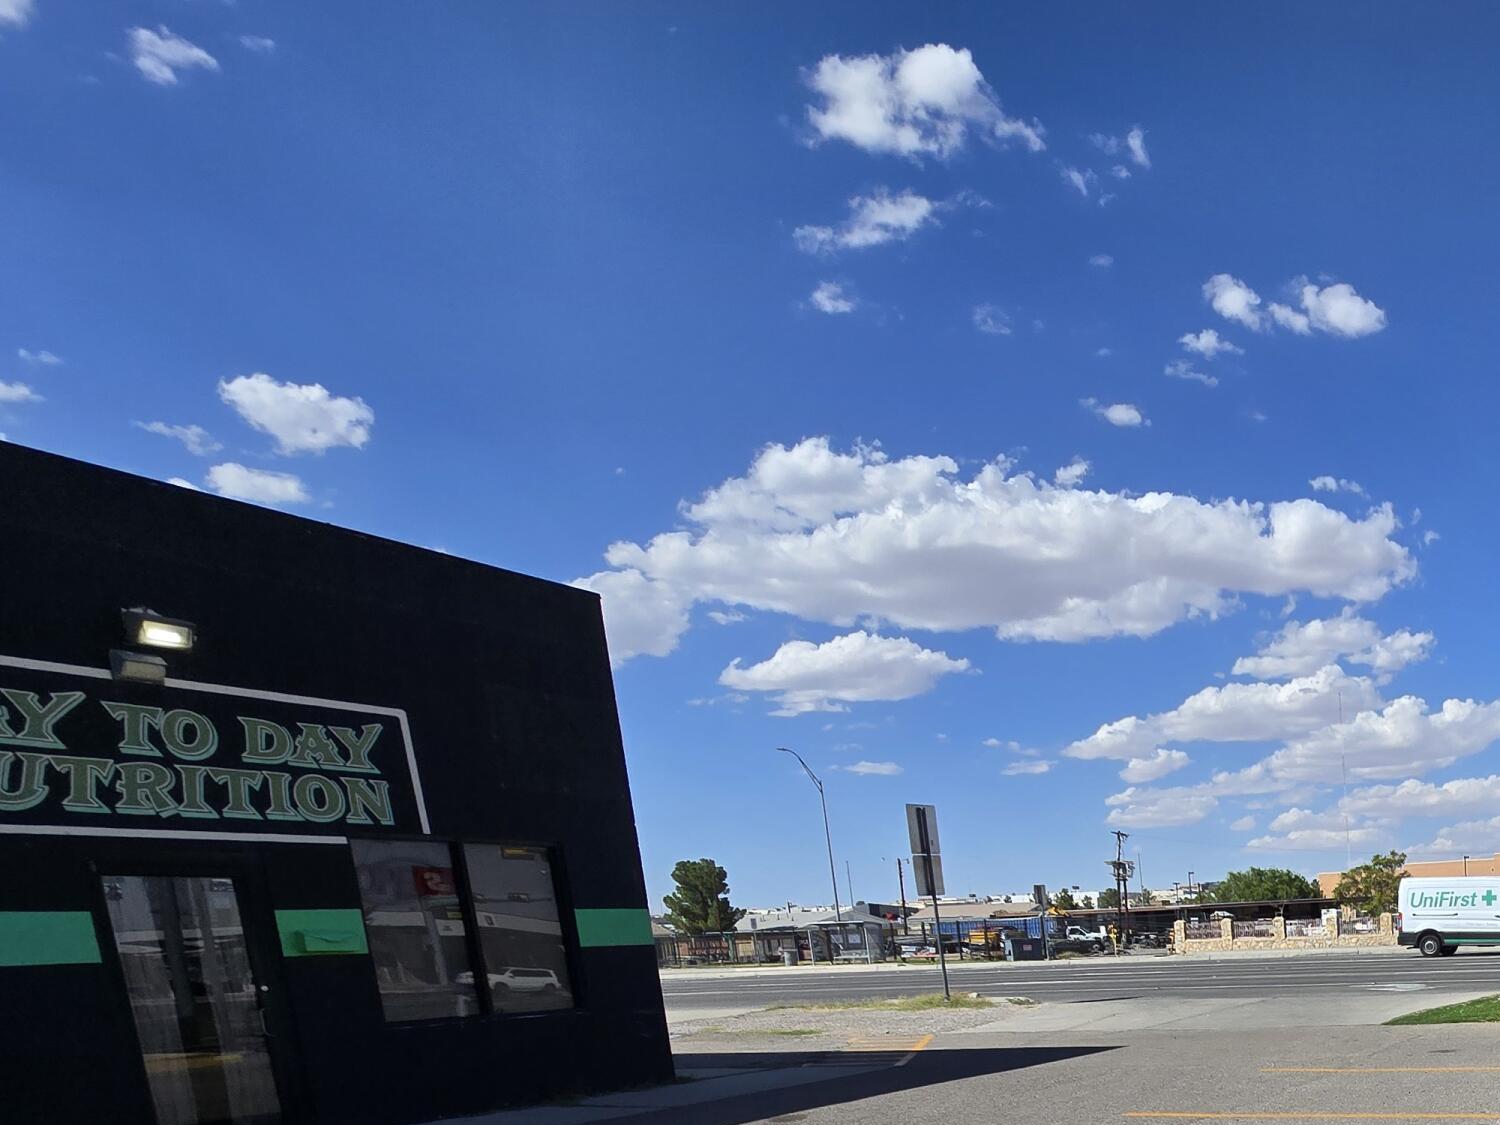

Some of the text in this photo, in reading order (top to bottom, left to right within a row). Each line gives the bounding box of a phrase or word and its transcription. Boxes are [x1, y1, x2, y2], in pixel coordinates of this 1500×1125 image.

[0, 688, 383, 774] Y TO DAY
[1410, 890, 1477, 908] UniFirst
